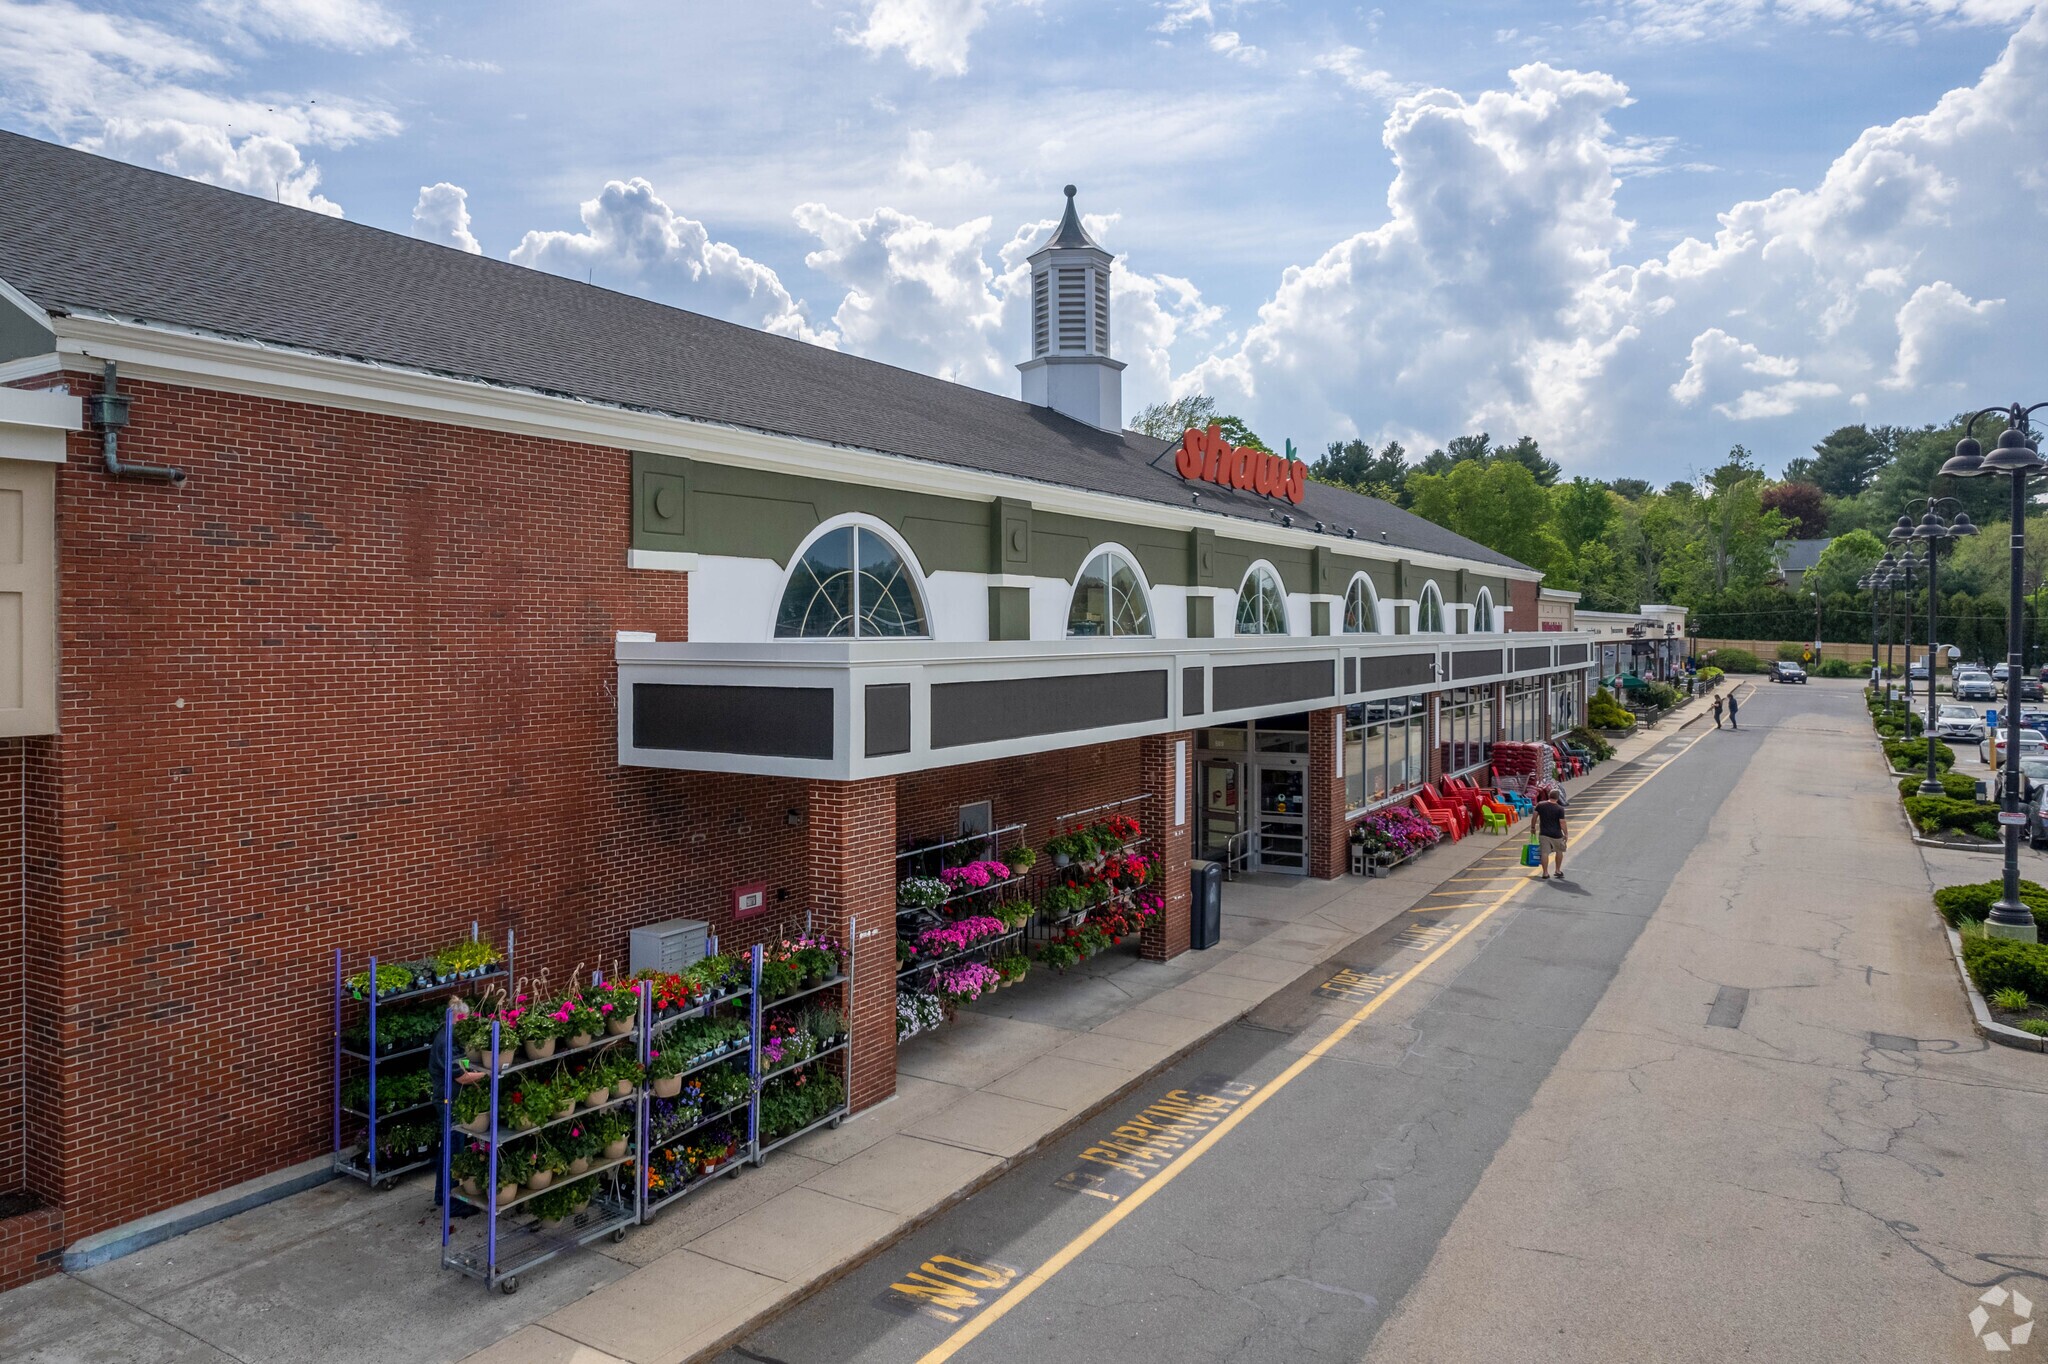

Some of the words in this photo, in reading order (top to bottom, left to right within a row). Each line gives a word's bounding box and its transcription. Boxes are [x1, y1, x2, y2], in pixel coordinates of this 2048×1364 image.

[889, 1255, 1016, 1317] NO
[1070, 1086, 1246, 1188] PARKING
[1321, 968, 1396, 999] FIRE
